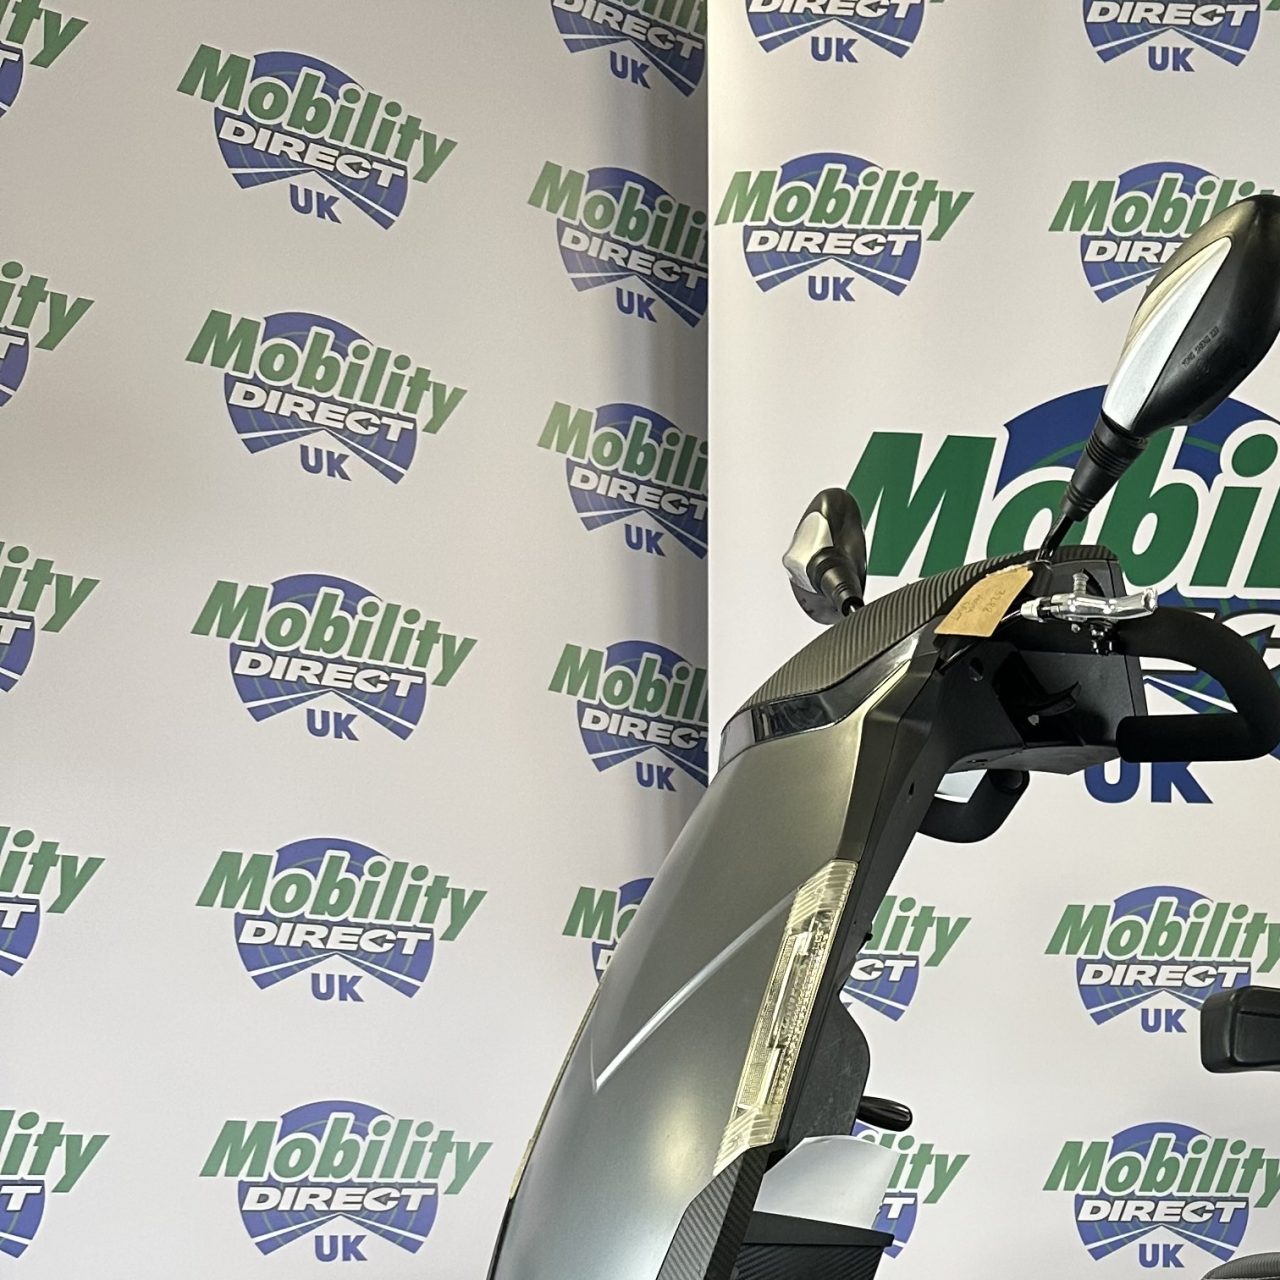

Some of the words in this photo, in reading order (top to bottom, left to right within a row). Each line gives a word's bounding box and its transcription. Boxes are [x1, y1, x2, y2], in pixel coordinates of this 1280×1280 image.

[553, 0, 703, 59] DIRECT
[1086, 1, 1259, 26] DIRECT
[811, 36, 858, 63] UK
[1148, 46, 1195, 72] UK
[610, 50, 651, 89] UK
[176, 44, 457, 183] Mobility
[217, 116, 406, 188] DIRECT
[289, 184, 342, 224] UK
[527, 160, 708, 266] Mobili
[715, 168, 974, 241] Mobility
[746, 232, 919, 256] DIRECT
[616, 287, 657, 322] UK
[808, 275, 855, 302] UK
[185, 309, 468, 434] Mobility
[228, 382, 414, 443] DIRECT
[300, 444, 352, 482] UK
[537, 401, 708, 494] Mobili
[624, 523, 666, 557] UK
[190, 580, 478, 688] Mobility
[233, 652, 424, 698] DIRECT
[548, 643, 708, 724] Mobil
[307, 708, 359, 742] UK
[636, 761, 677, 792] UK
[195, 850, 487, 942] Mobility
[238, 919, 431, 955] DIRECT
[311, 973, 364, 1003] UK
[1080, 964, 1249, 988] DIRECT
[1140, 1008, 1187, 1033] UK
[199, 1113, 493, 1195] Mobility
[242, 1186, 435, 1212] DIRECT
[1077, 1200, 1247, 1223] DIRECT
[314, 1235, 367, 1263] UK
[1138, 1243, 1185, 1268] UK
